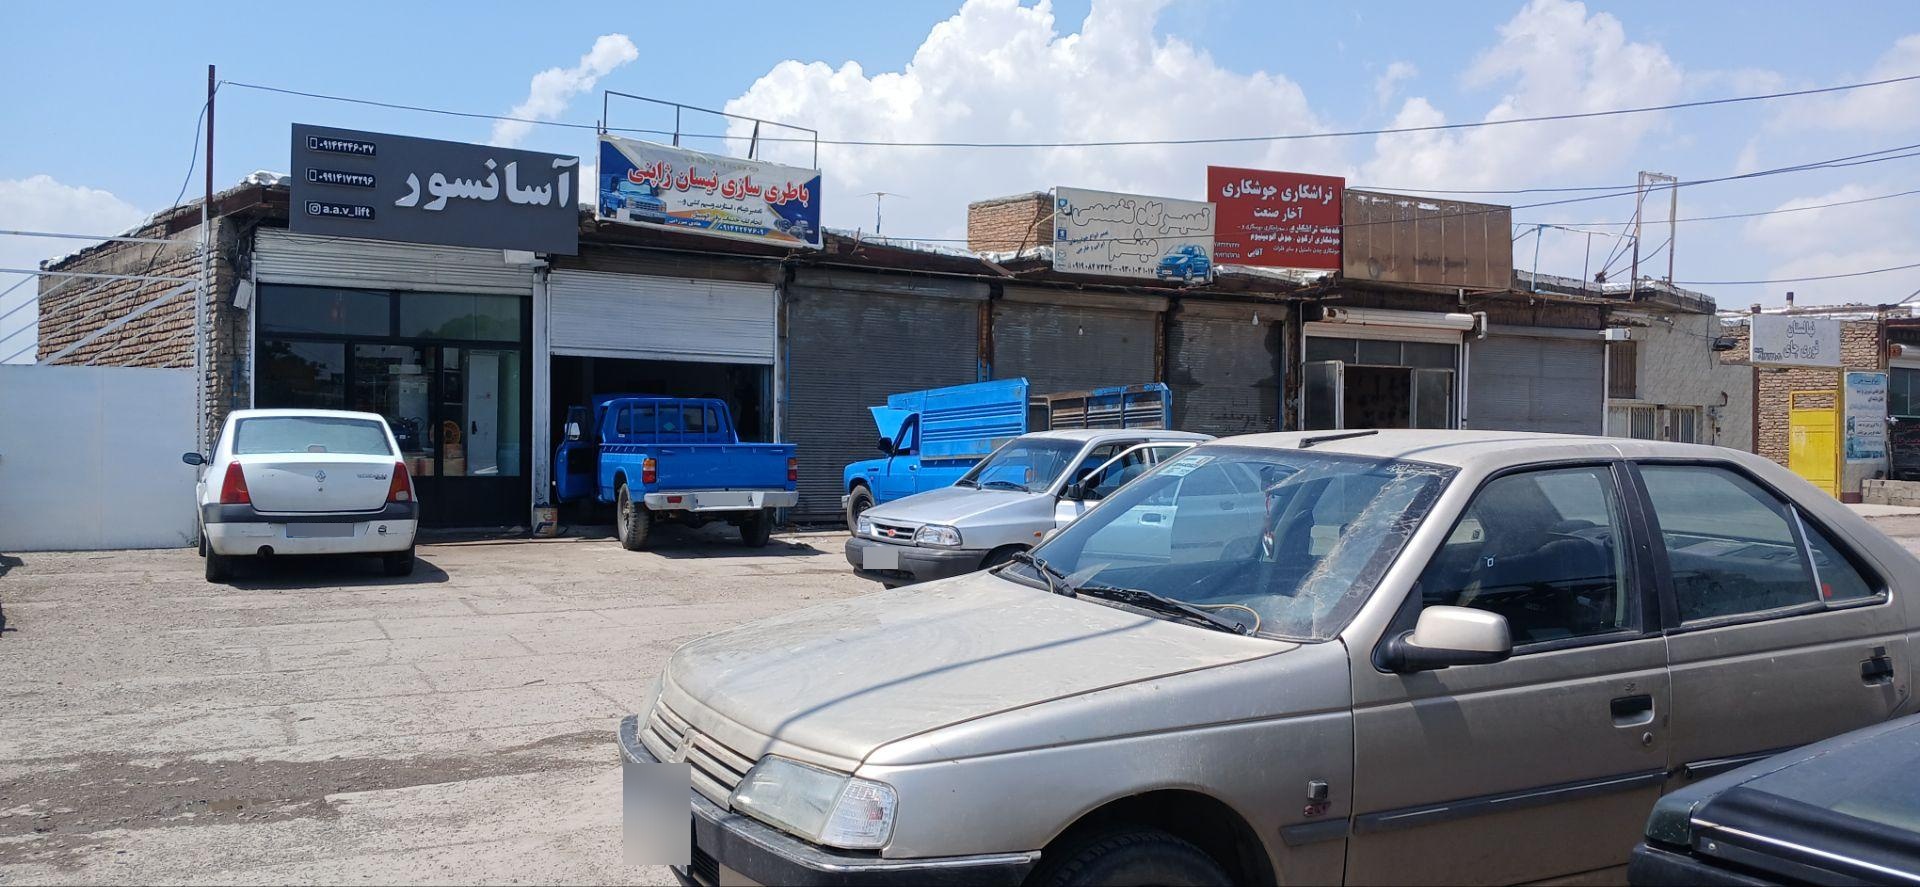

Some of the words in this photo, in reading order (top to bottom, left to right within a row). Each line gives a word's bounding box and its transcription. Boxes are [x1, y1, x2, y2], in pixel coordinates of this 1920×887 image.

[395, 157, 579, 211] آسانسور
[628, 160, 672, 189] ژاپنی
[676, 165, 719, 195] نیسان
[721, 175, 761, 201] سازی
[764, 181, 810, 208] باطری
[1222, 178, 1278, 201] جوشکاری
[1280, 183, 1333, 205] تراشکاری
[322, 205, 370, 217] a.a.v_lift
[1253, 207, 1280, 218] صنعت
